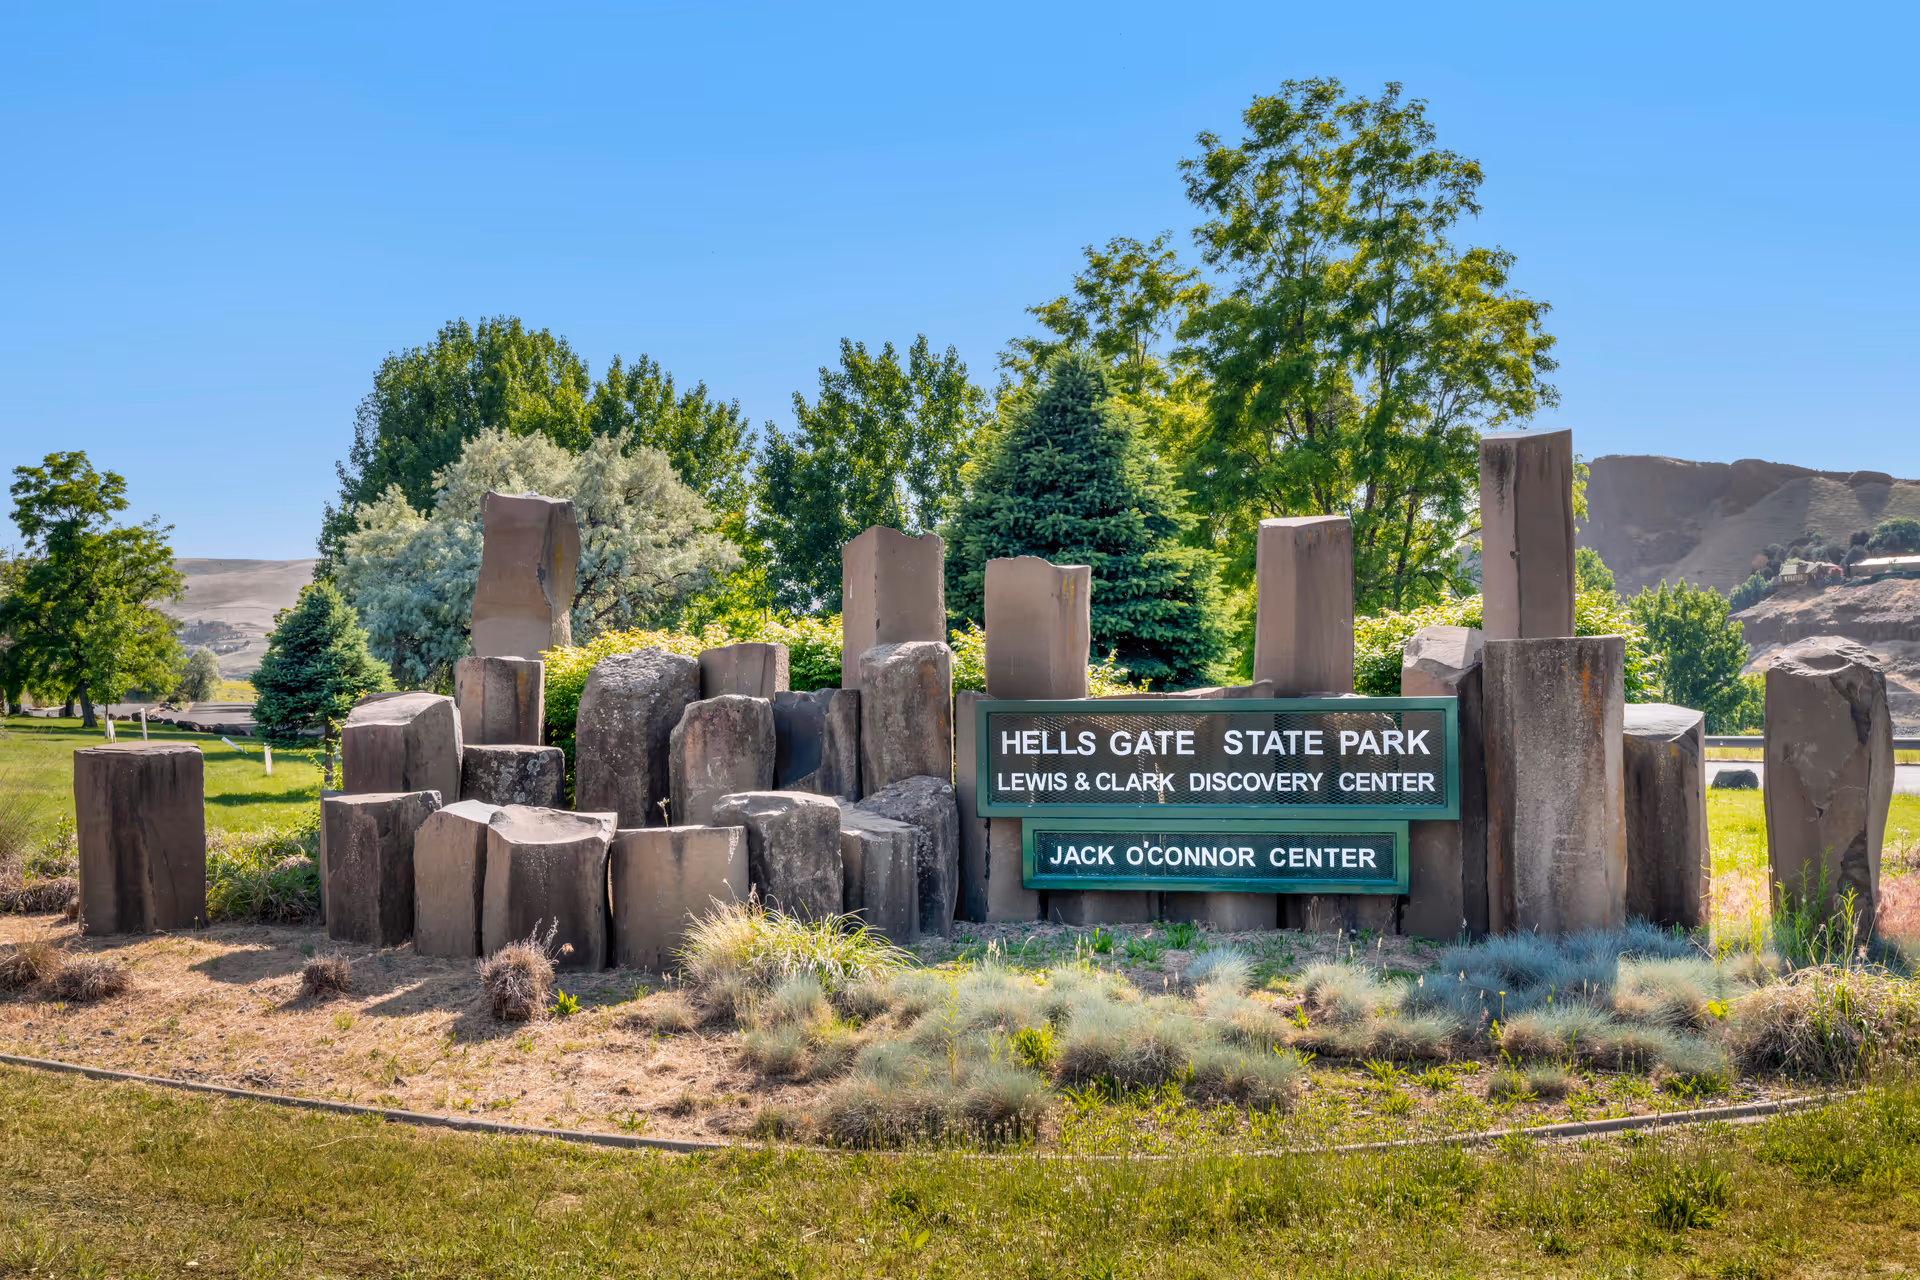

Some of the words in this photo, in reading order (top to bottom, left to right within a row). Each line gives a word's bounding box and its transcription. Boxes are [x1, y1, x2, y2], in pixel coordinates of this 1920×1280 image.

[1001, 730, 1096, 756] HELLS
[1109, 730, 1195, 756] GATE
[1223, 729, 1324, 756] STATE
[1340, 729, 1431, 756] PARK
[997, 772, 1068, 792] LEWIS
[1074, 772, 1090, 792] &
[1095, 772, 1175, 792] CLARK
[1189, 772, 1324, 792] DISCOVERY
[1338, 772, 1435, 792] CENTER
[1049, 845, 1115, 866] JACK
[1126, 841, 1255, 867] O'CONNOR
[1269, 847, 1377, 868] CENTER
